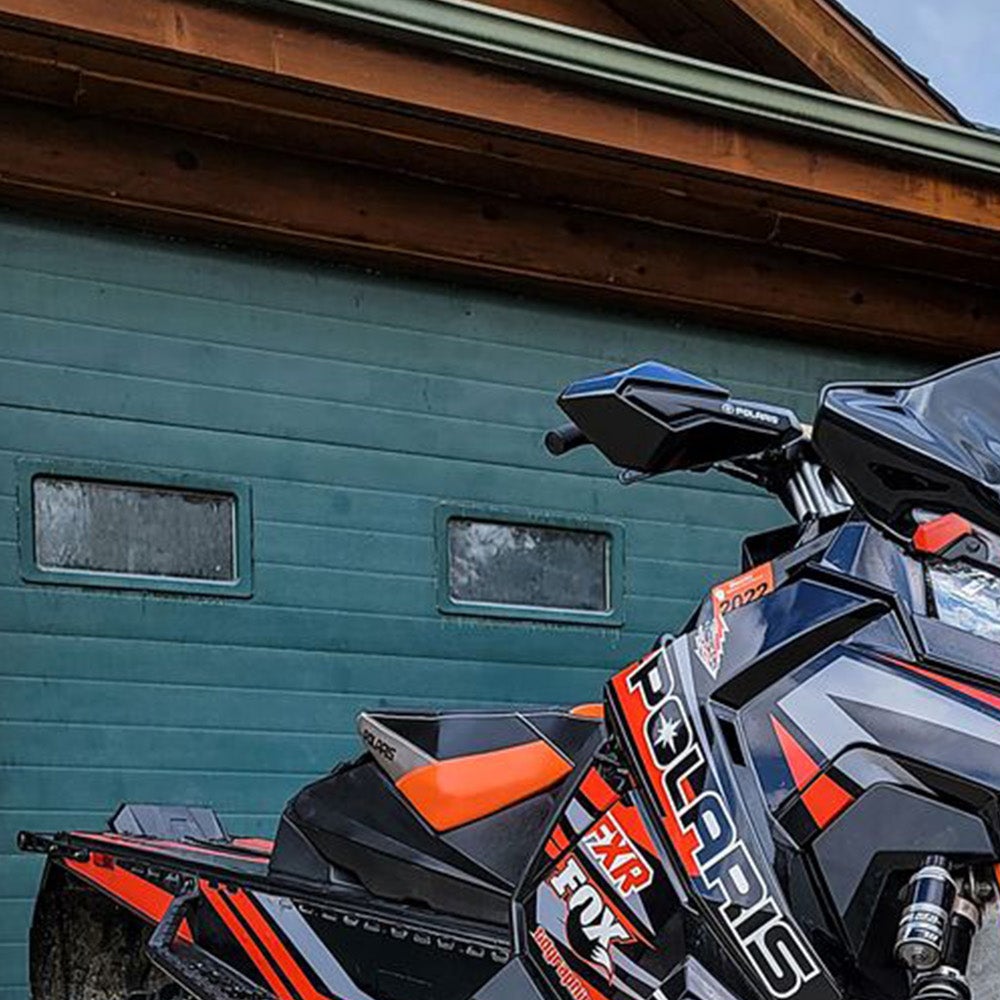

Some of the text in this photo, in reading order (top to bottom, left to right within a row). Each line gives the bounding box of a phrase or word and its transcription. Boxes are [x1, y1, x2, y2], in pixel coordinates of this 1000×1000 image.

[719, 583, 768, 616] 2022
[586, 813, 653, 898] FXR
[628, 646, 820, 998] POLARIS
[550, 857, 631, 948] FOX
